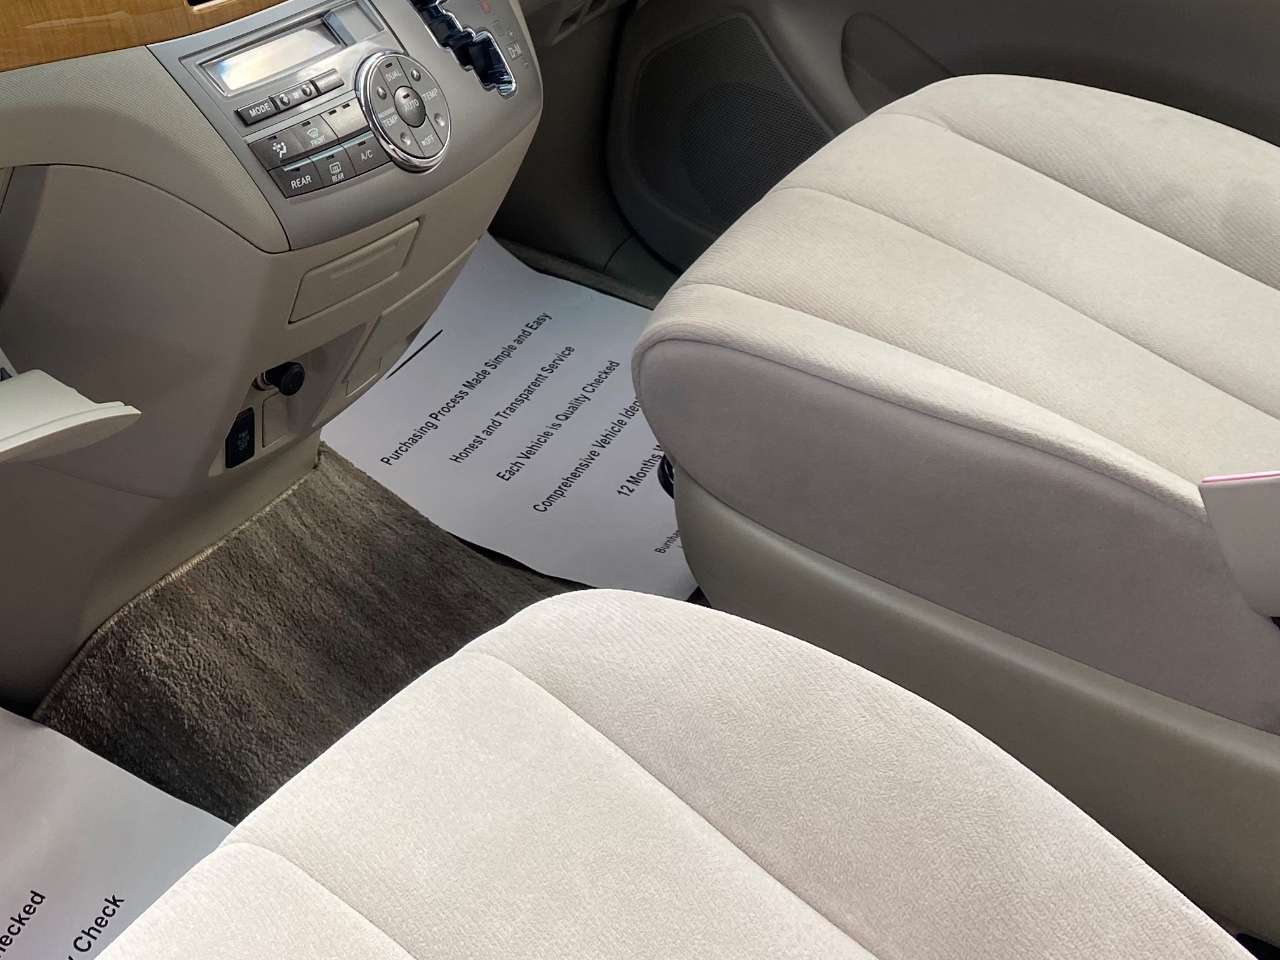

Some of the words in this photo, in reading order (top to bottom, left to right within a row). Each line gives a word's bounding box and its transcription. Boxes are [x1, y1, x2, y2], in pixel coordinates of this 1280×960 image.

[249, 103, 271, 117] MODE
[403, 99, 420, 112] AUTO
[360, 150, 373, 161] A/C
[291, 175, 312, 189] REAR
[380, 421, 438, 466] Purchasing
[429, 390, 469, 422] Process
[462, 369, 491, 391] Made
[484, 344, 517, 370] Simple
[513, 329, 532, 346] and
[525, 312, 553, 331] Easy
[582, 360, 620, 394] Checked
[449, 435, 486, 464] Honest
[482, 419, 502, 436] and
[495, 373, 549, 420] Transparent
[541, 345, 575, 375] Service
[555, 393, 591, 422] Quality
[549, 421, 562, 431] is
[517, 430, 554, 460] Vehicle
[533, 449, 600, 513] Comprehensive
[592, 418, 627, 449] Vehicle
[618, 400, 641, 420] Iden
[496, 460, 525, 481] Each
[617, 484, 635, 497] 12
[626, 452, 663, 486] Months
[73, 894, 125, 952] Check
